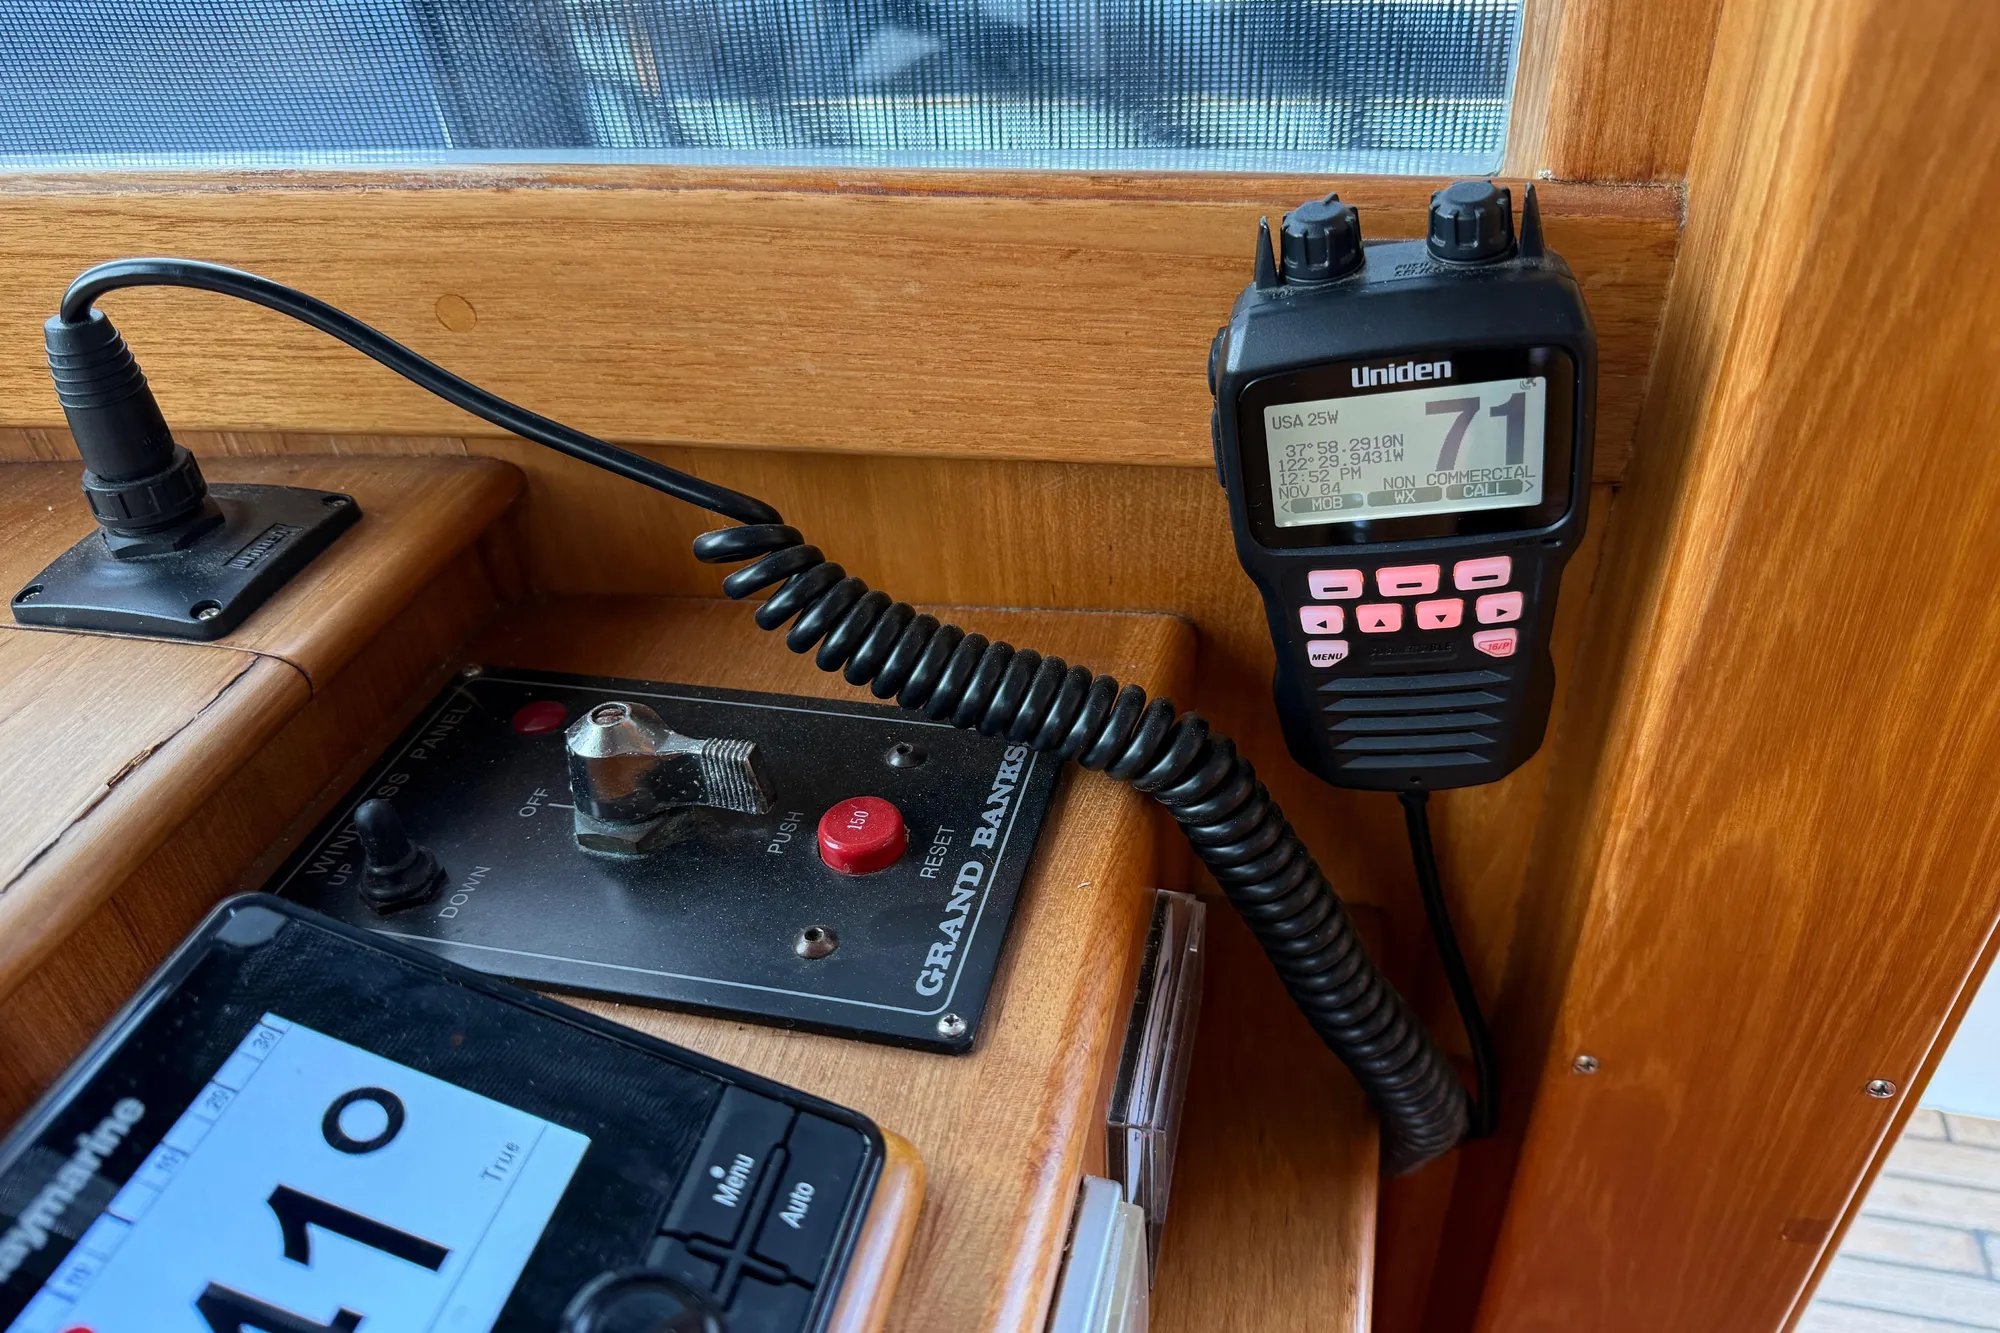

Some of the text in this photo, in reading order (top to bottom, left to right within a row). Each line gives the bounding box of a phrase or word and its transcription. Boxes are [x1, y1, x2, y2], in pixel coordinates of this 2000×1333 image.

[1351, 360, 1452, 388] Uniden
[1272, 410, 1339, 430] USA 25W
[1425, 391, 1526, 472] 71
[1279, 467, 1362, 487] 12:52 PM
[1279, 482, 1341, 500] NOV 04
[1383, 465, 1536, 490] NON COMMERCIAL
[1463, 480, 1507, 498] CALL
[1311, 496, 1344, 511] MOB
[1394, 489, 1416, 504] WX
[1311, 652, 1343, 662] MENU
[306, 703, 474, 875] WINDSS PANEL
[518, 787, 549, 818] OFF
[766, 811, 804, 854] PUSH
[847, 810, 869, 830] 150
[919, 825, 955, 879] RESET
[327, 863, 354, 886] UP
[915, 743, 1029, 997] GRAND BANKS
[438, 864, 492, 919] DOWN
[479, 1140, 522, 1184] True
[0, 1096, 146, 1284] aymarine
[712, 1153, 756, 1209] Menu
[778, 1181, 816, 1230] Auto
